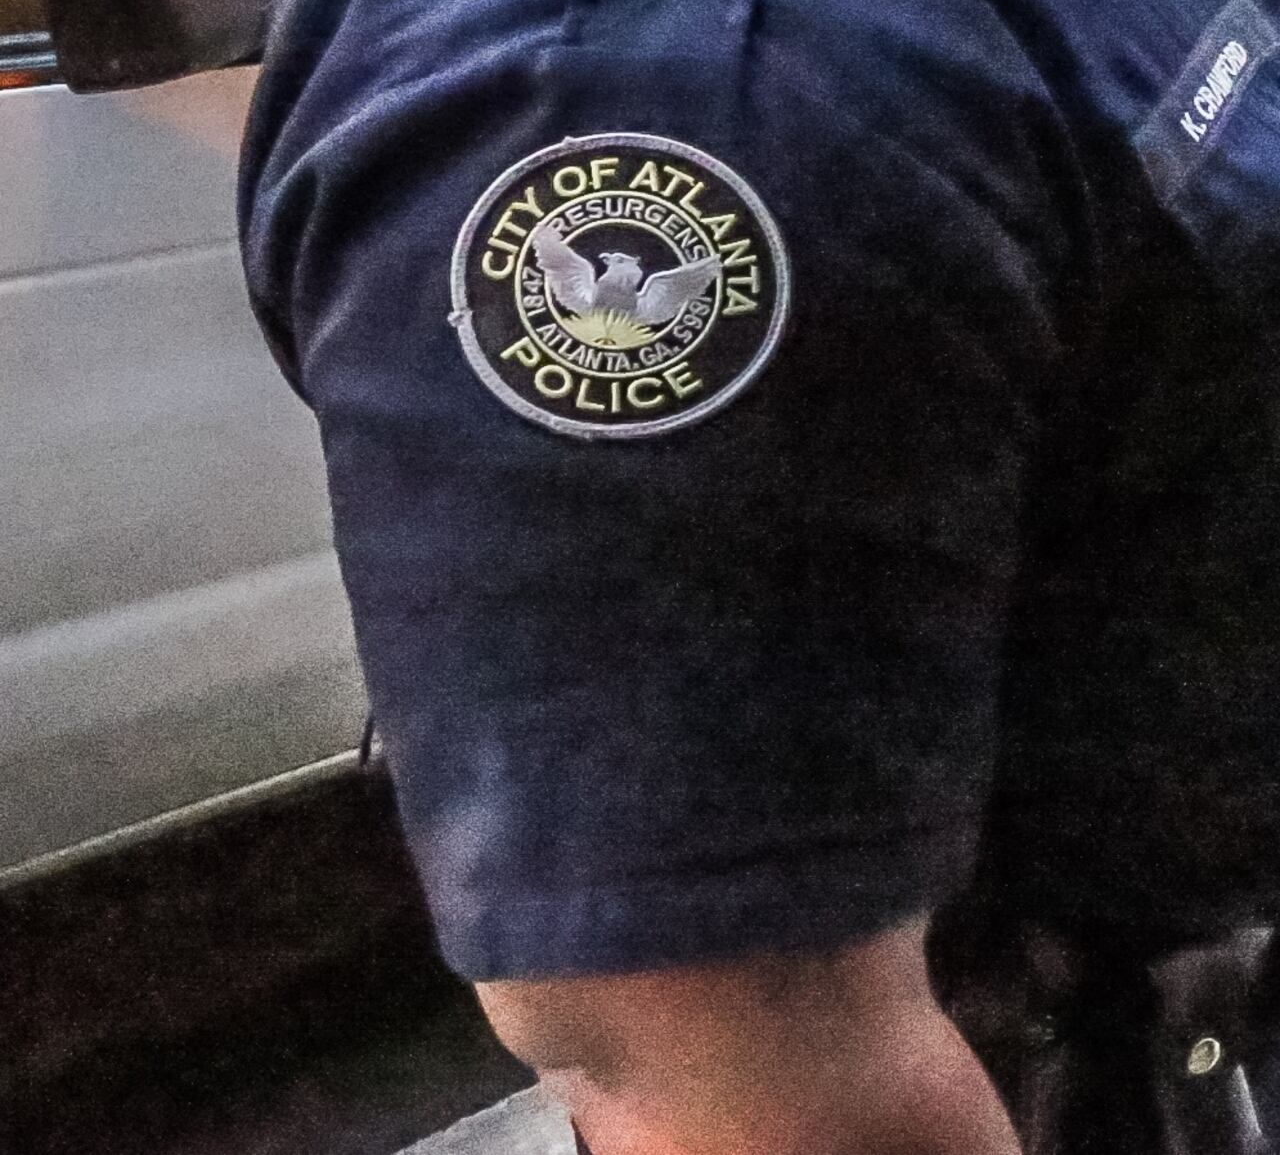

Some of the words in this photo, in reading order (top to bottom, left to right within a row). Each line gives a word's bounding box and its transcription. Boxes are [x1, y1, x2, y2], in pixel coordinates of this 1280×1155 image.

[482, 185, 545, 280] CITY
[552, 157, 620, 197] OF
[629, 160, 760, 317] ATLANTA
[550, 196, 709, 262] RESURGENS
[500, 336, 703, 413] POLICE
